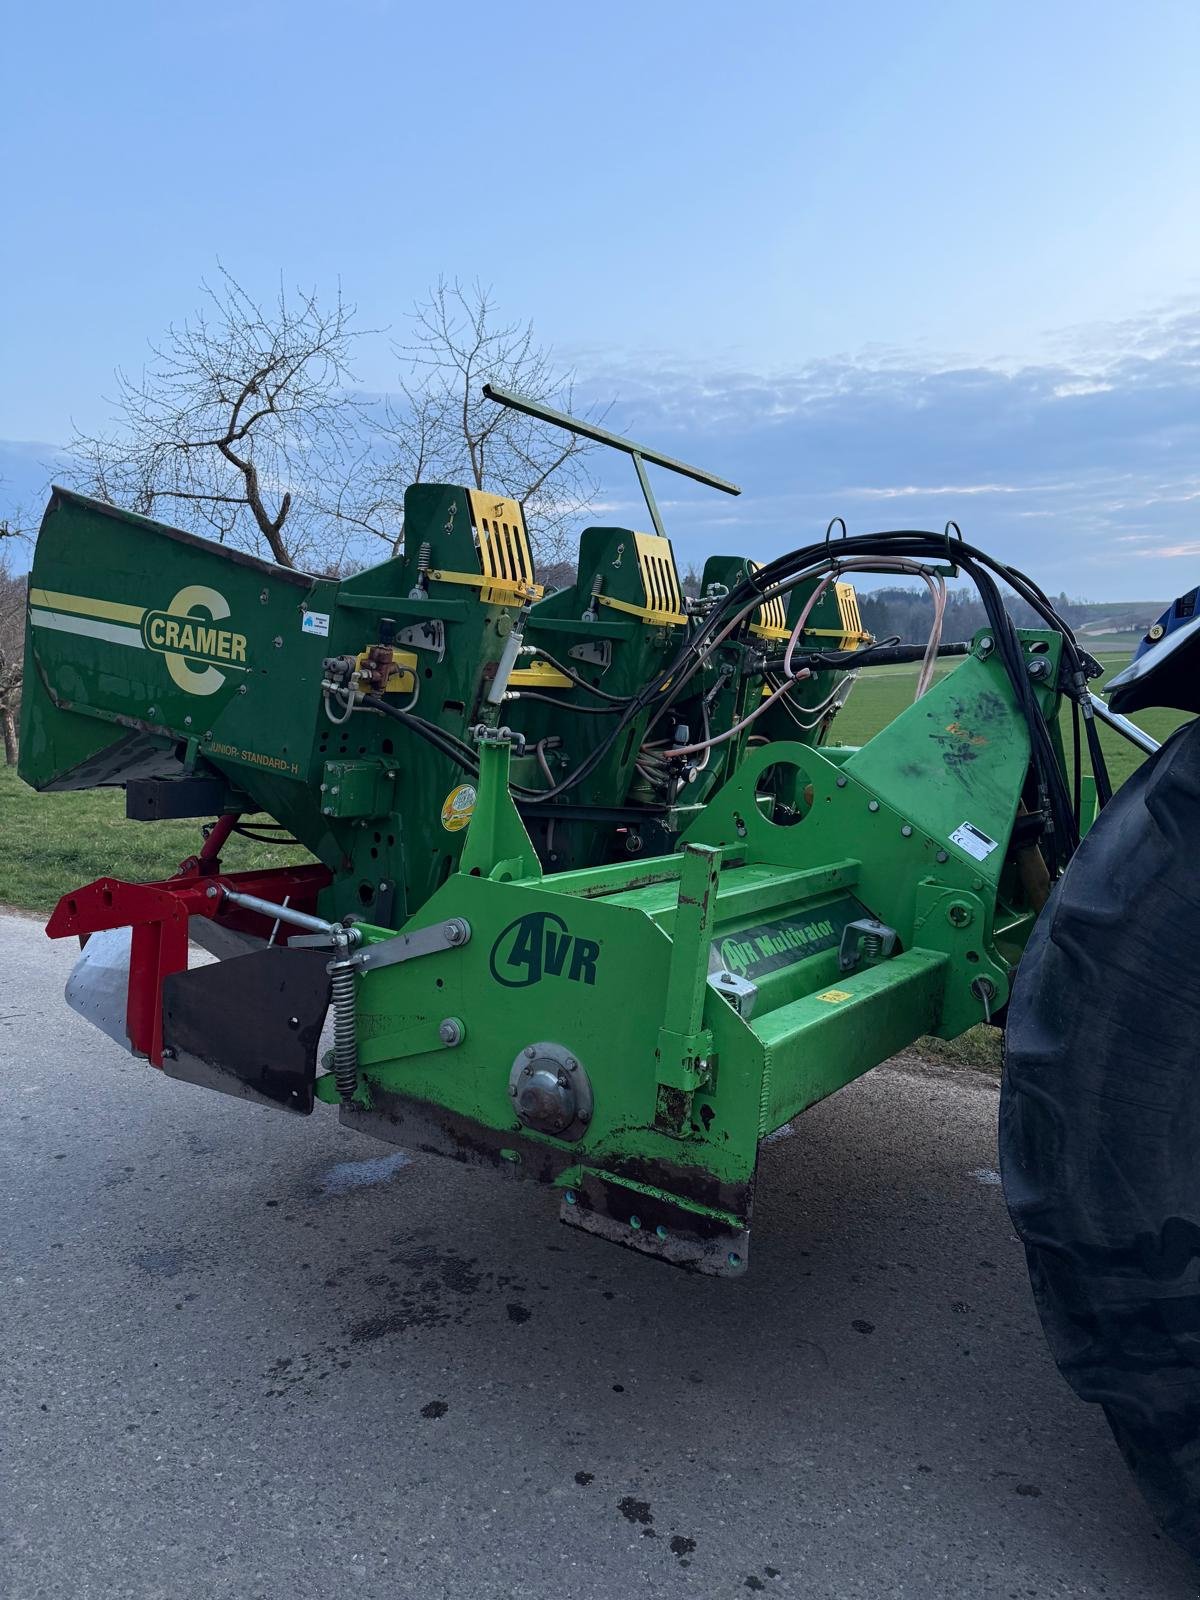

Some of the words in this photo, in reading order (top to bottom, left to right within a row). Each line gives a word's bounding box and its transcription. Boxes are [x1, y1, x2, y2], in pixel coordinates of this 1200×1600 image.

[150, 618, 247, 662] CRAMER
[291, 763, 299, 774] H
[489, 911, 600, 988] AVR
[721, 938, 760, 978] AVR
[754, 919, 834, 958] Multivator
